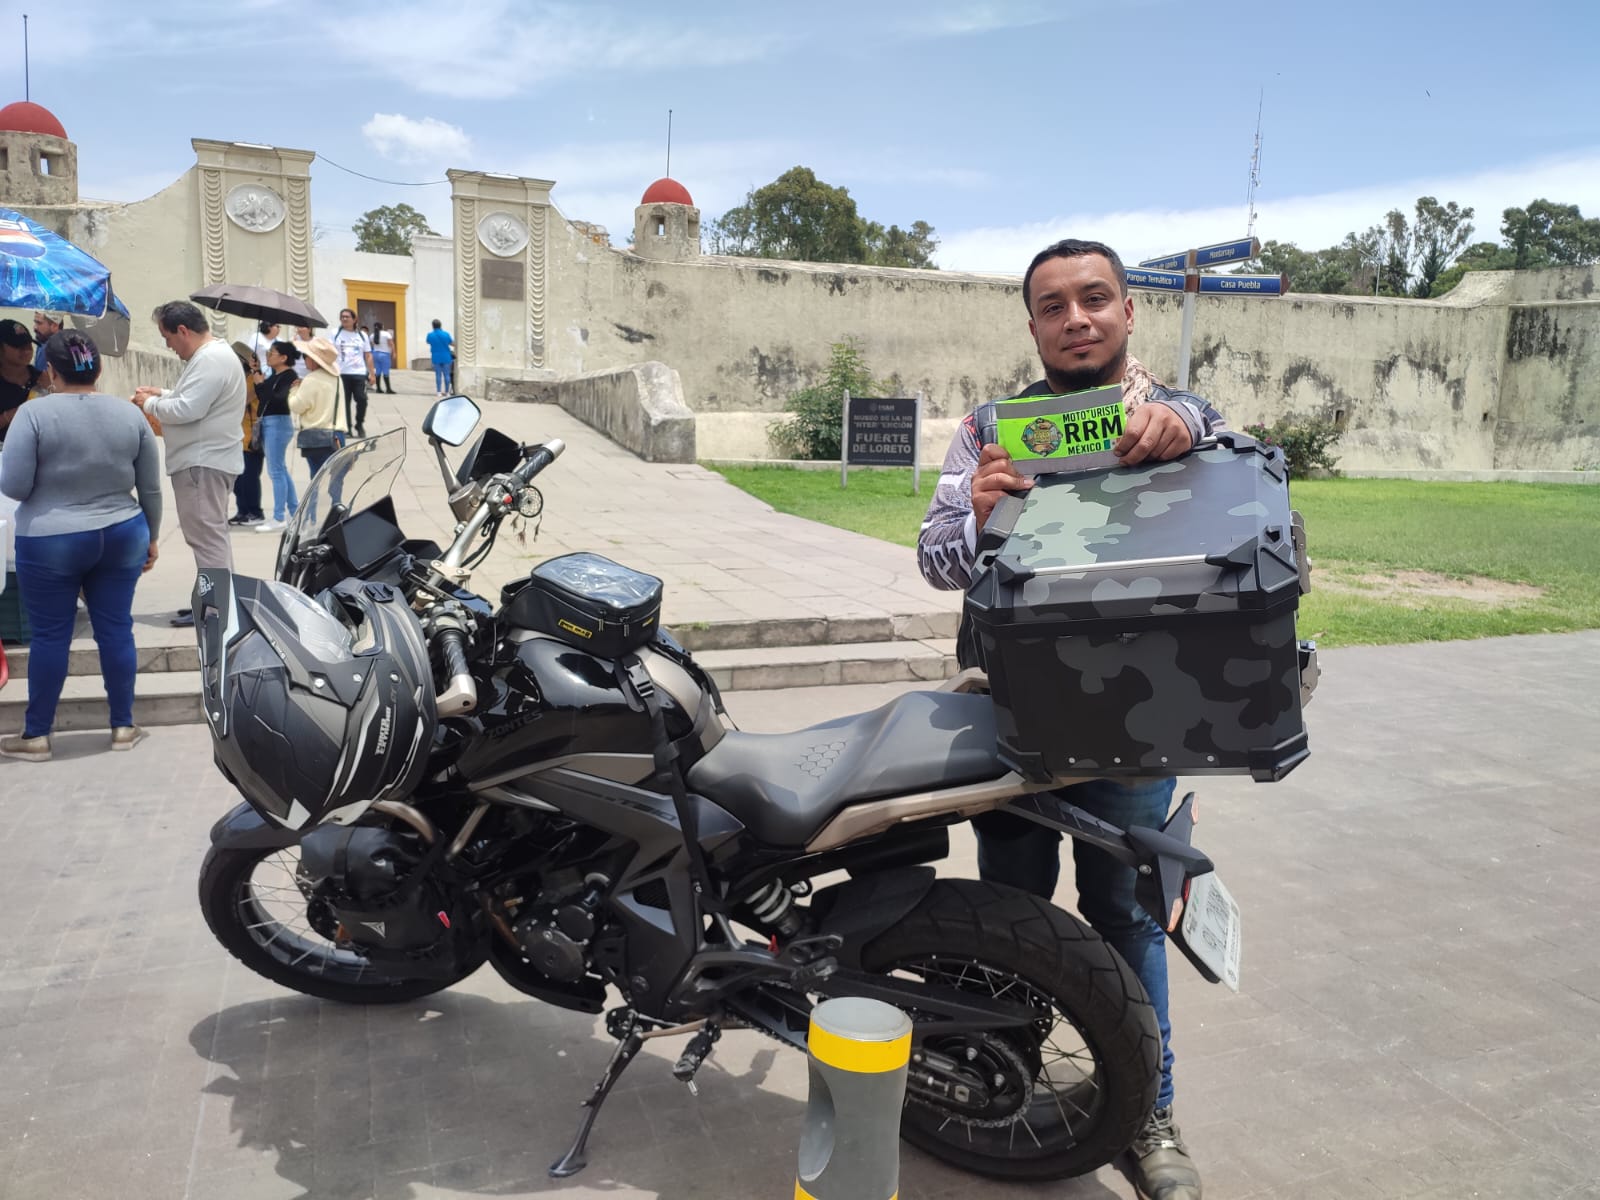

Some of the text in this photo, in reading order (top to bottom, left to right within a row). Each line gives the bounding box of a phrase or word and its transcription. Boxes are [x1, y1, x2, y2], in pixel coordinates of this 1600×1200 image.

[1221, 280, 1261, 289] Casa Puebla
[1064, 414, 1123, 444] RRM
[856, 433, 909, 443] FUERTE
[853, 444, 912, 454] DE LORETO
